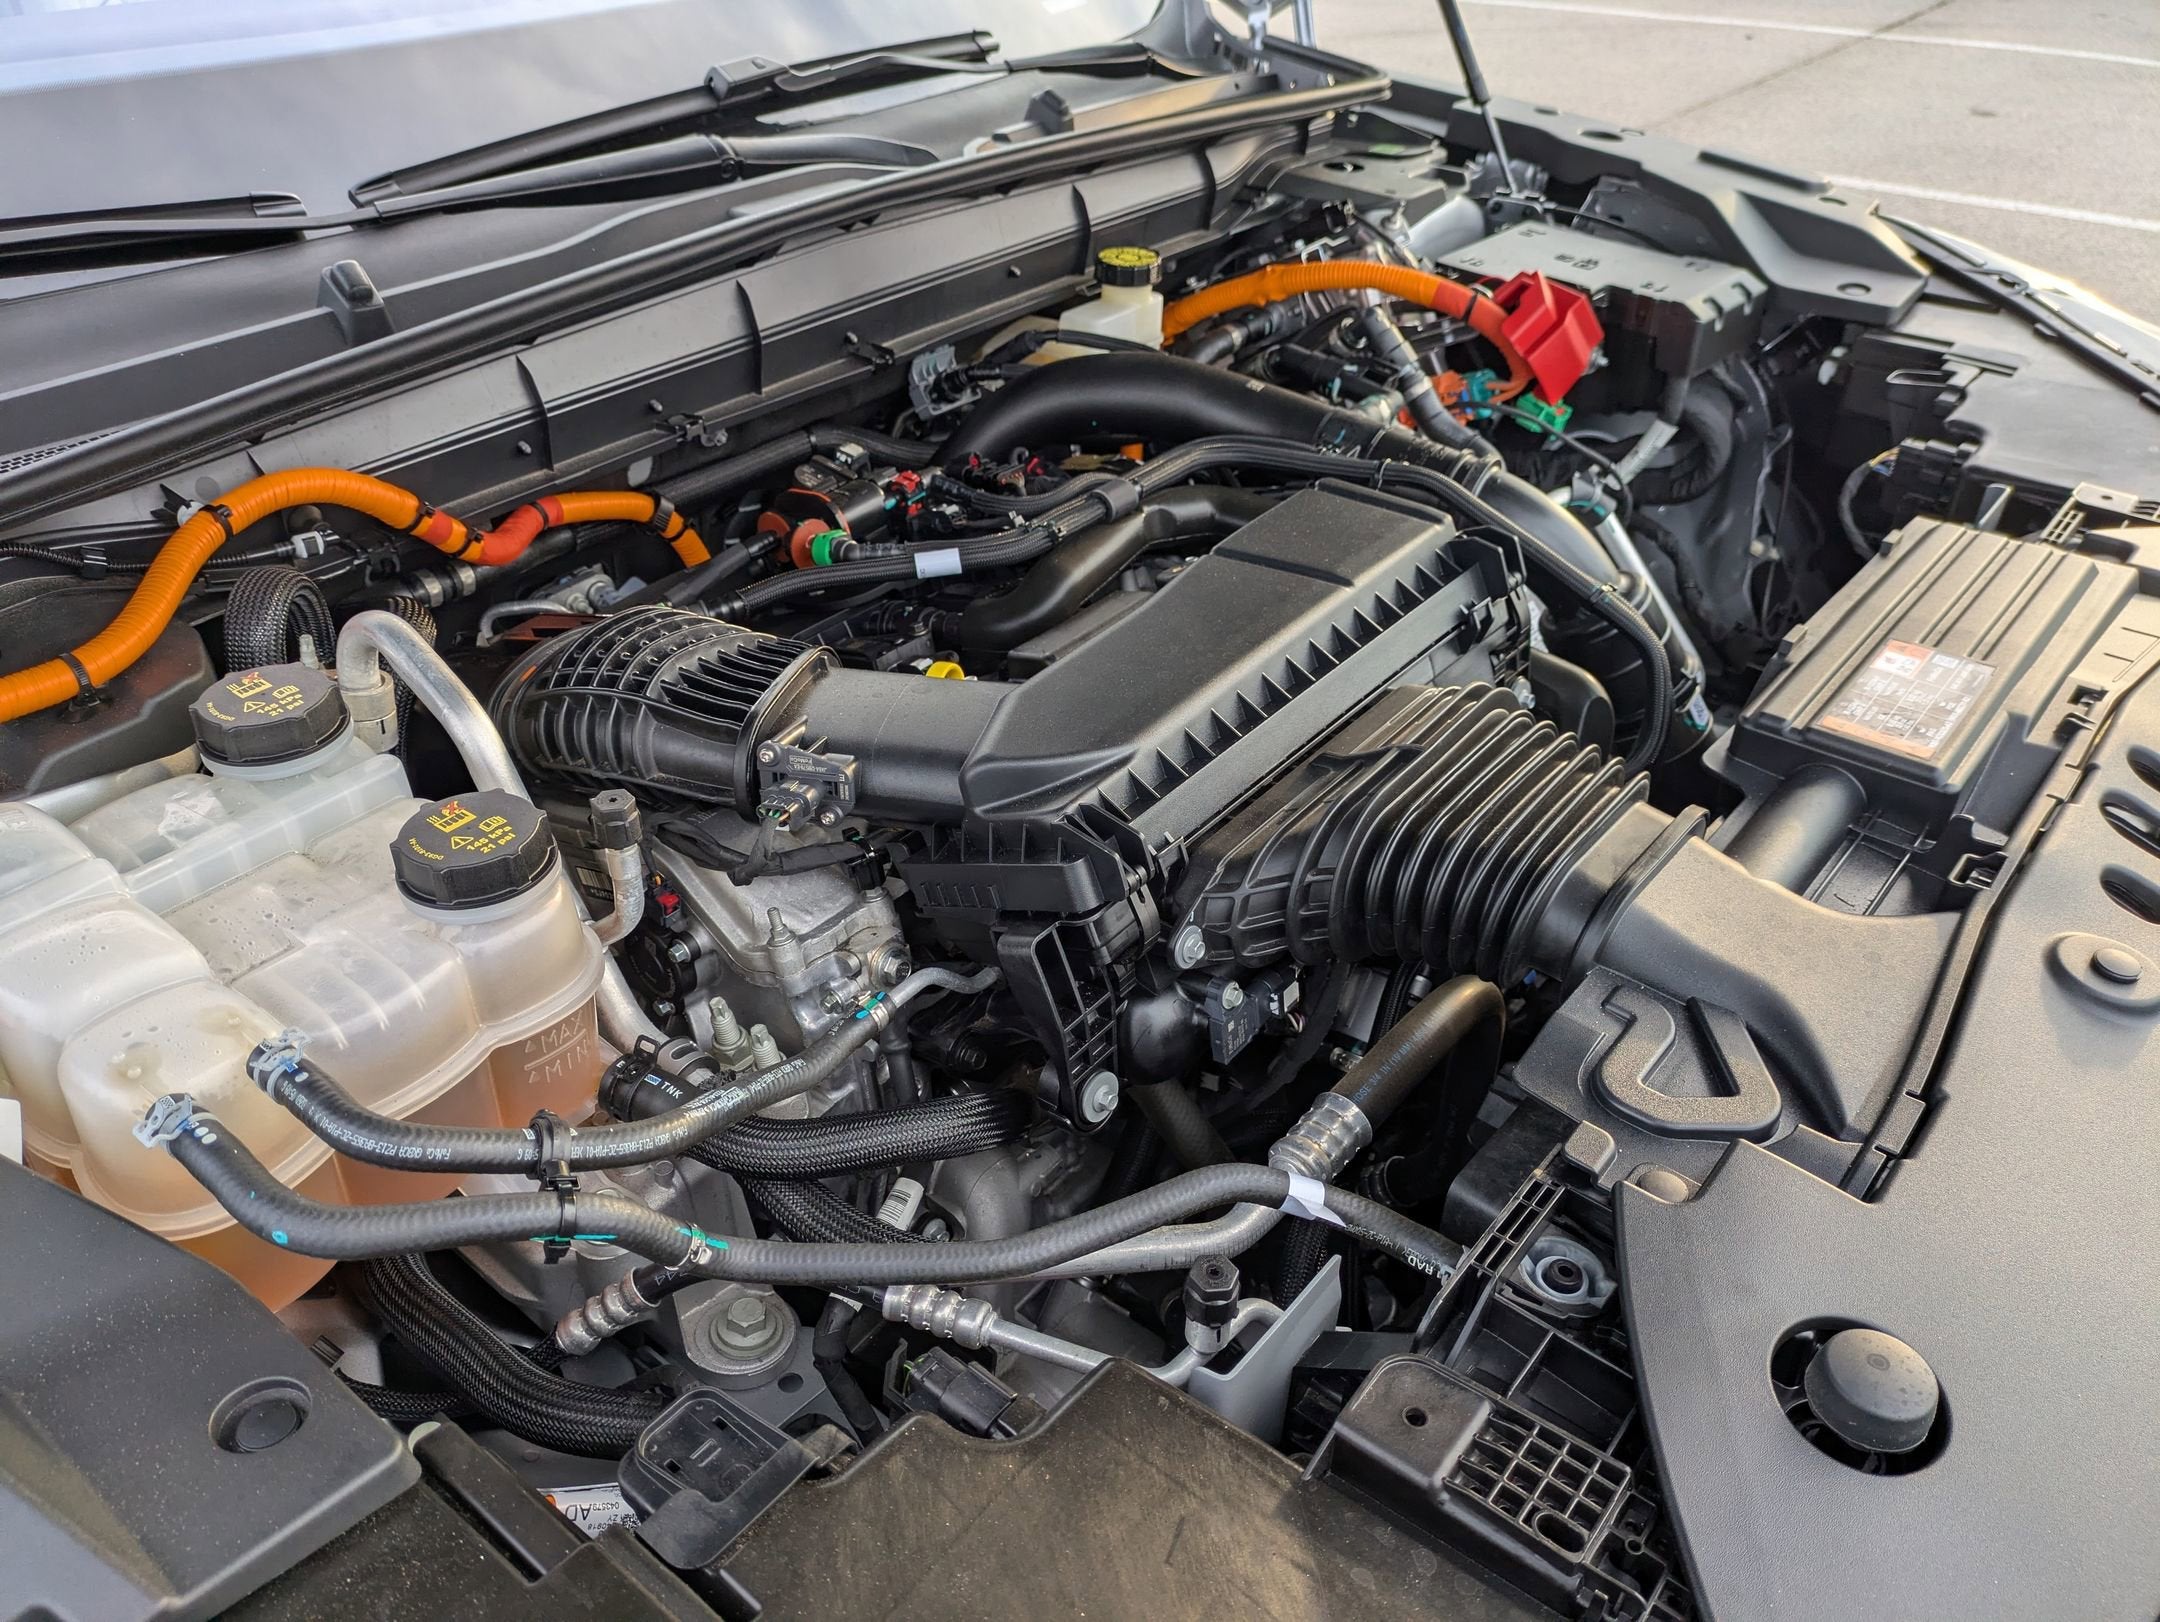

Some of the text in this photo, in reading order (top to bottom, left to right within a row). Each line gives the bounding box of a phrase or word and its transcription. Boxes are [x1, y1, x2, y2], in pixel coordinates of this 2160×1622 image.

[466, 826, 512, 850] 145 kPa
[480, 832, 516, 853] 21 psi
[541, 1010, 584, 1053] MAX
[545, 1039, 588, 1083] MIN
[660, 1081, 684, 1099] TNK
[1407, 1255, 1434, 1275] RAD
[565, 1503, 592, 1521] AD
[592, 1502, 619, 1511] 043579
